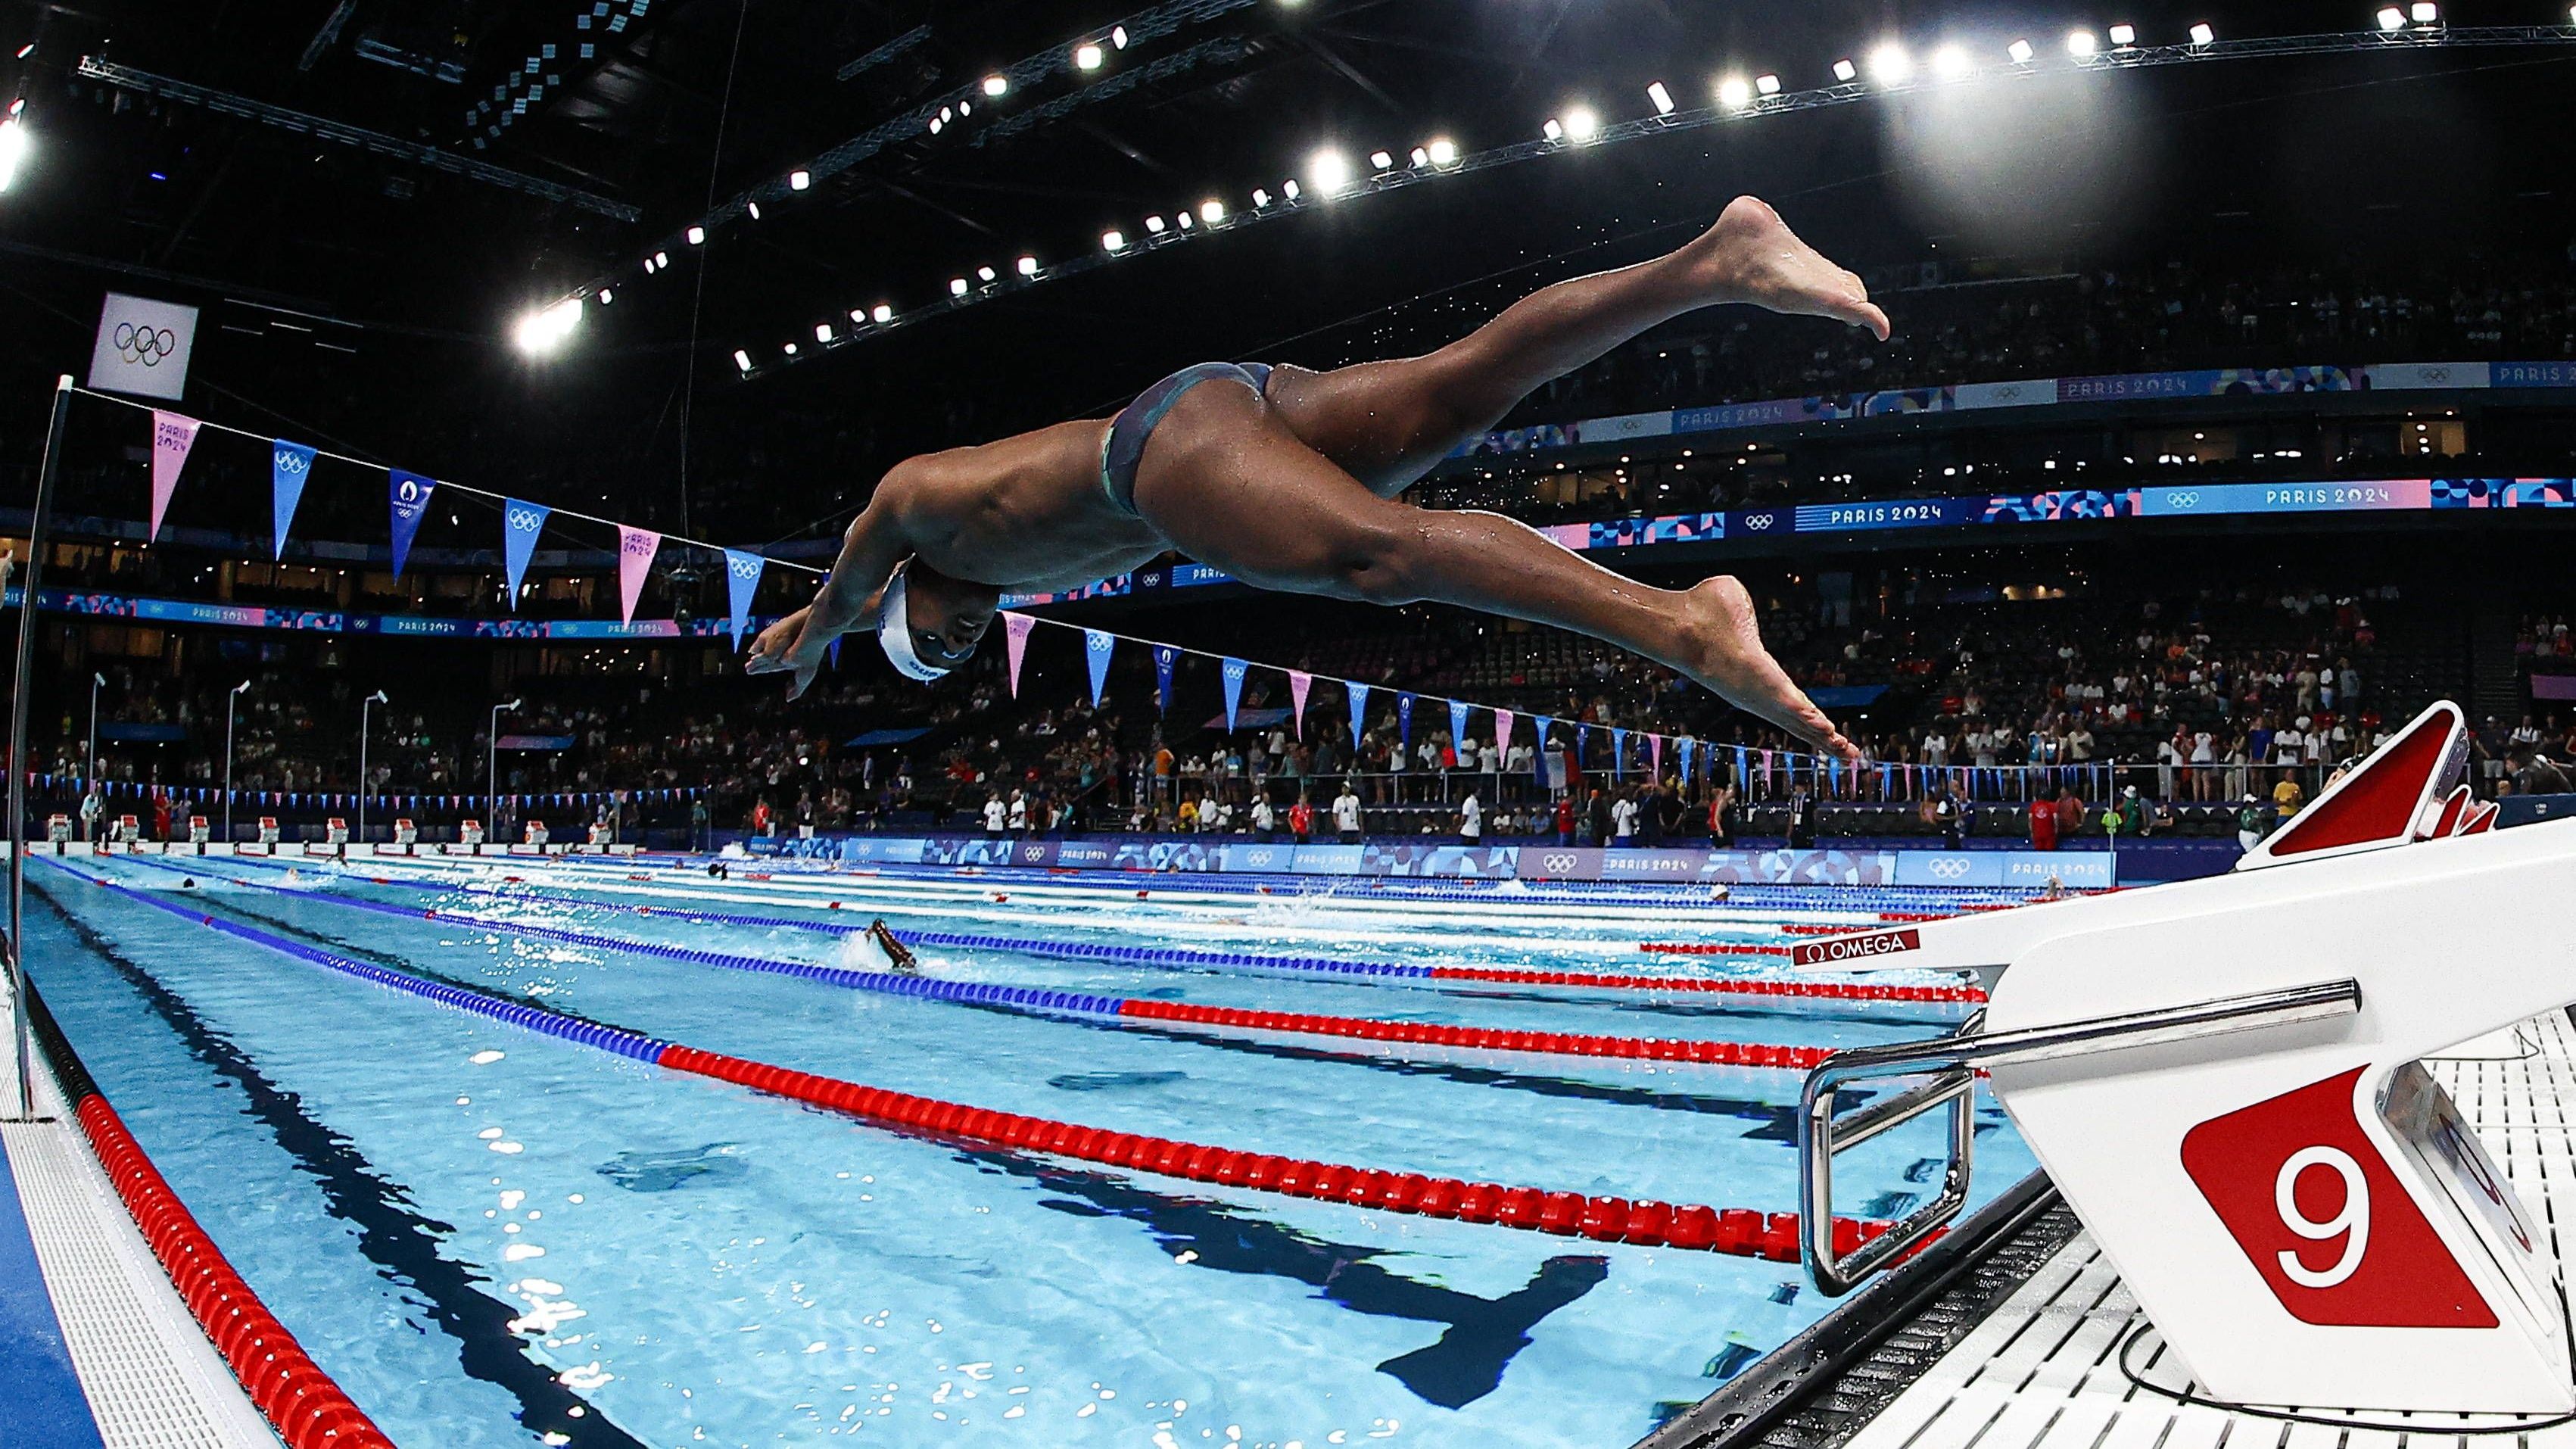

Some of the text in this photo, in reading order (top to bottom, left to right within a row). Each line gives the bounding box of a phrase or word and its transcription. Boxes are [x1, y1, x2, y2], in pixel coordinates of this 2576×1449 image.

[2500, 367, 2560, 382] PARIS
[2067, 377, 2187, 397] PARIS 2024
[1680, 405, 1783, 428] PARIS 2024
[159, 422, 189, 441] PARIS
[157, 435, 186, 452] 2024
[2266, 488, 2389, 503] PARIS 2024
[1831, 504, 1941, 524] PARIS 2024
[398, 621, 427, 631] PARIS
[1609, 858, 1688, 872] PARIS 2024
[2012, 862, 2059, 874] PARIS
[1830, 933, 1906, 959] OMEGA
[2275, 1145, 2371, 1289] 9
